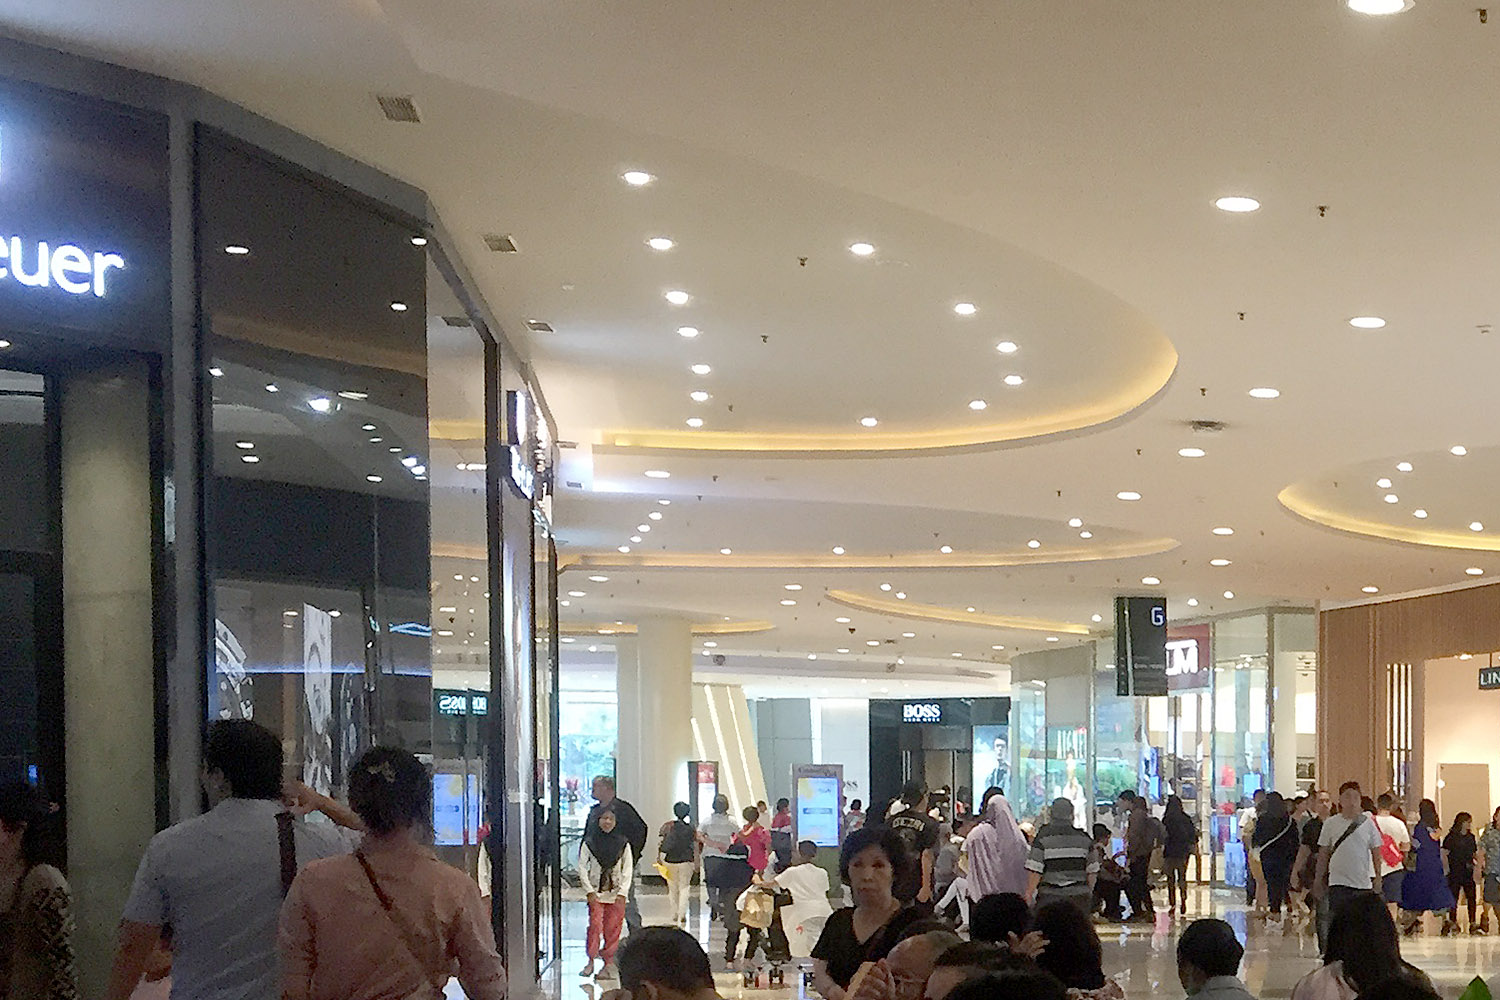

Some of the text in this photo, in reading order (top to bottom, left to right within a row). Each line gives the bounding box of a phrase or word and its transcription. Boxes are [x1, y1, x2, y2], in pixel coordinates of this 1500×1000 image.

[0, 235, 125, 297] uer
[1151, 606, 1165, 626] G
[903, 704, 941, 718] BOSS
